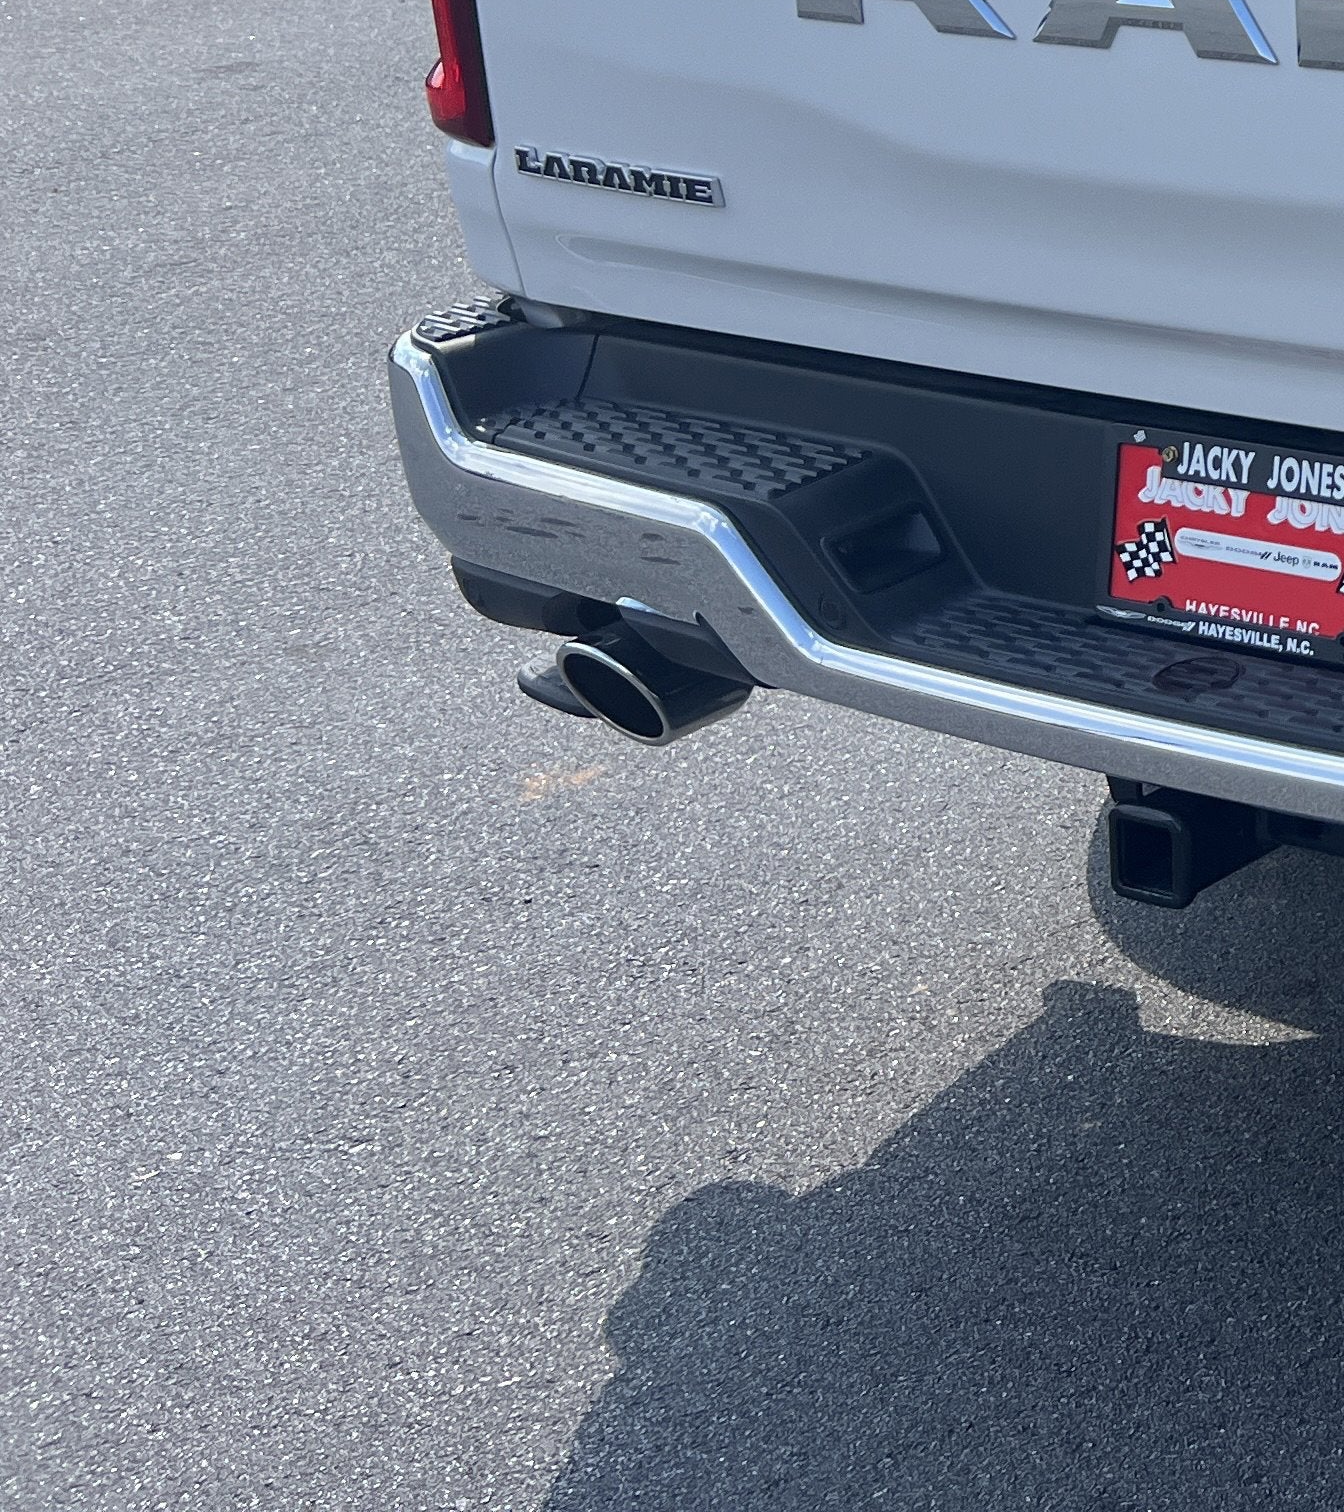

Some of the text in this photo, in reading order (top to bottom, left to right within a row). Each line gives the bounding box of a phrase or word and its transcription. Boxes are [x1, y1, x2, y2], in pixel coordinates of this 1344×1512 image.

[514, 144, 722, 208] LARAMIE
[1176, 441, 1256, 484] JACKY
[1273, 551, 1300, 567] Jeep
[1198, 621, 1284, 652] HAYESVILLE,
[1286, 638, 1315, 656] N.C.
